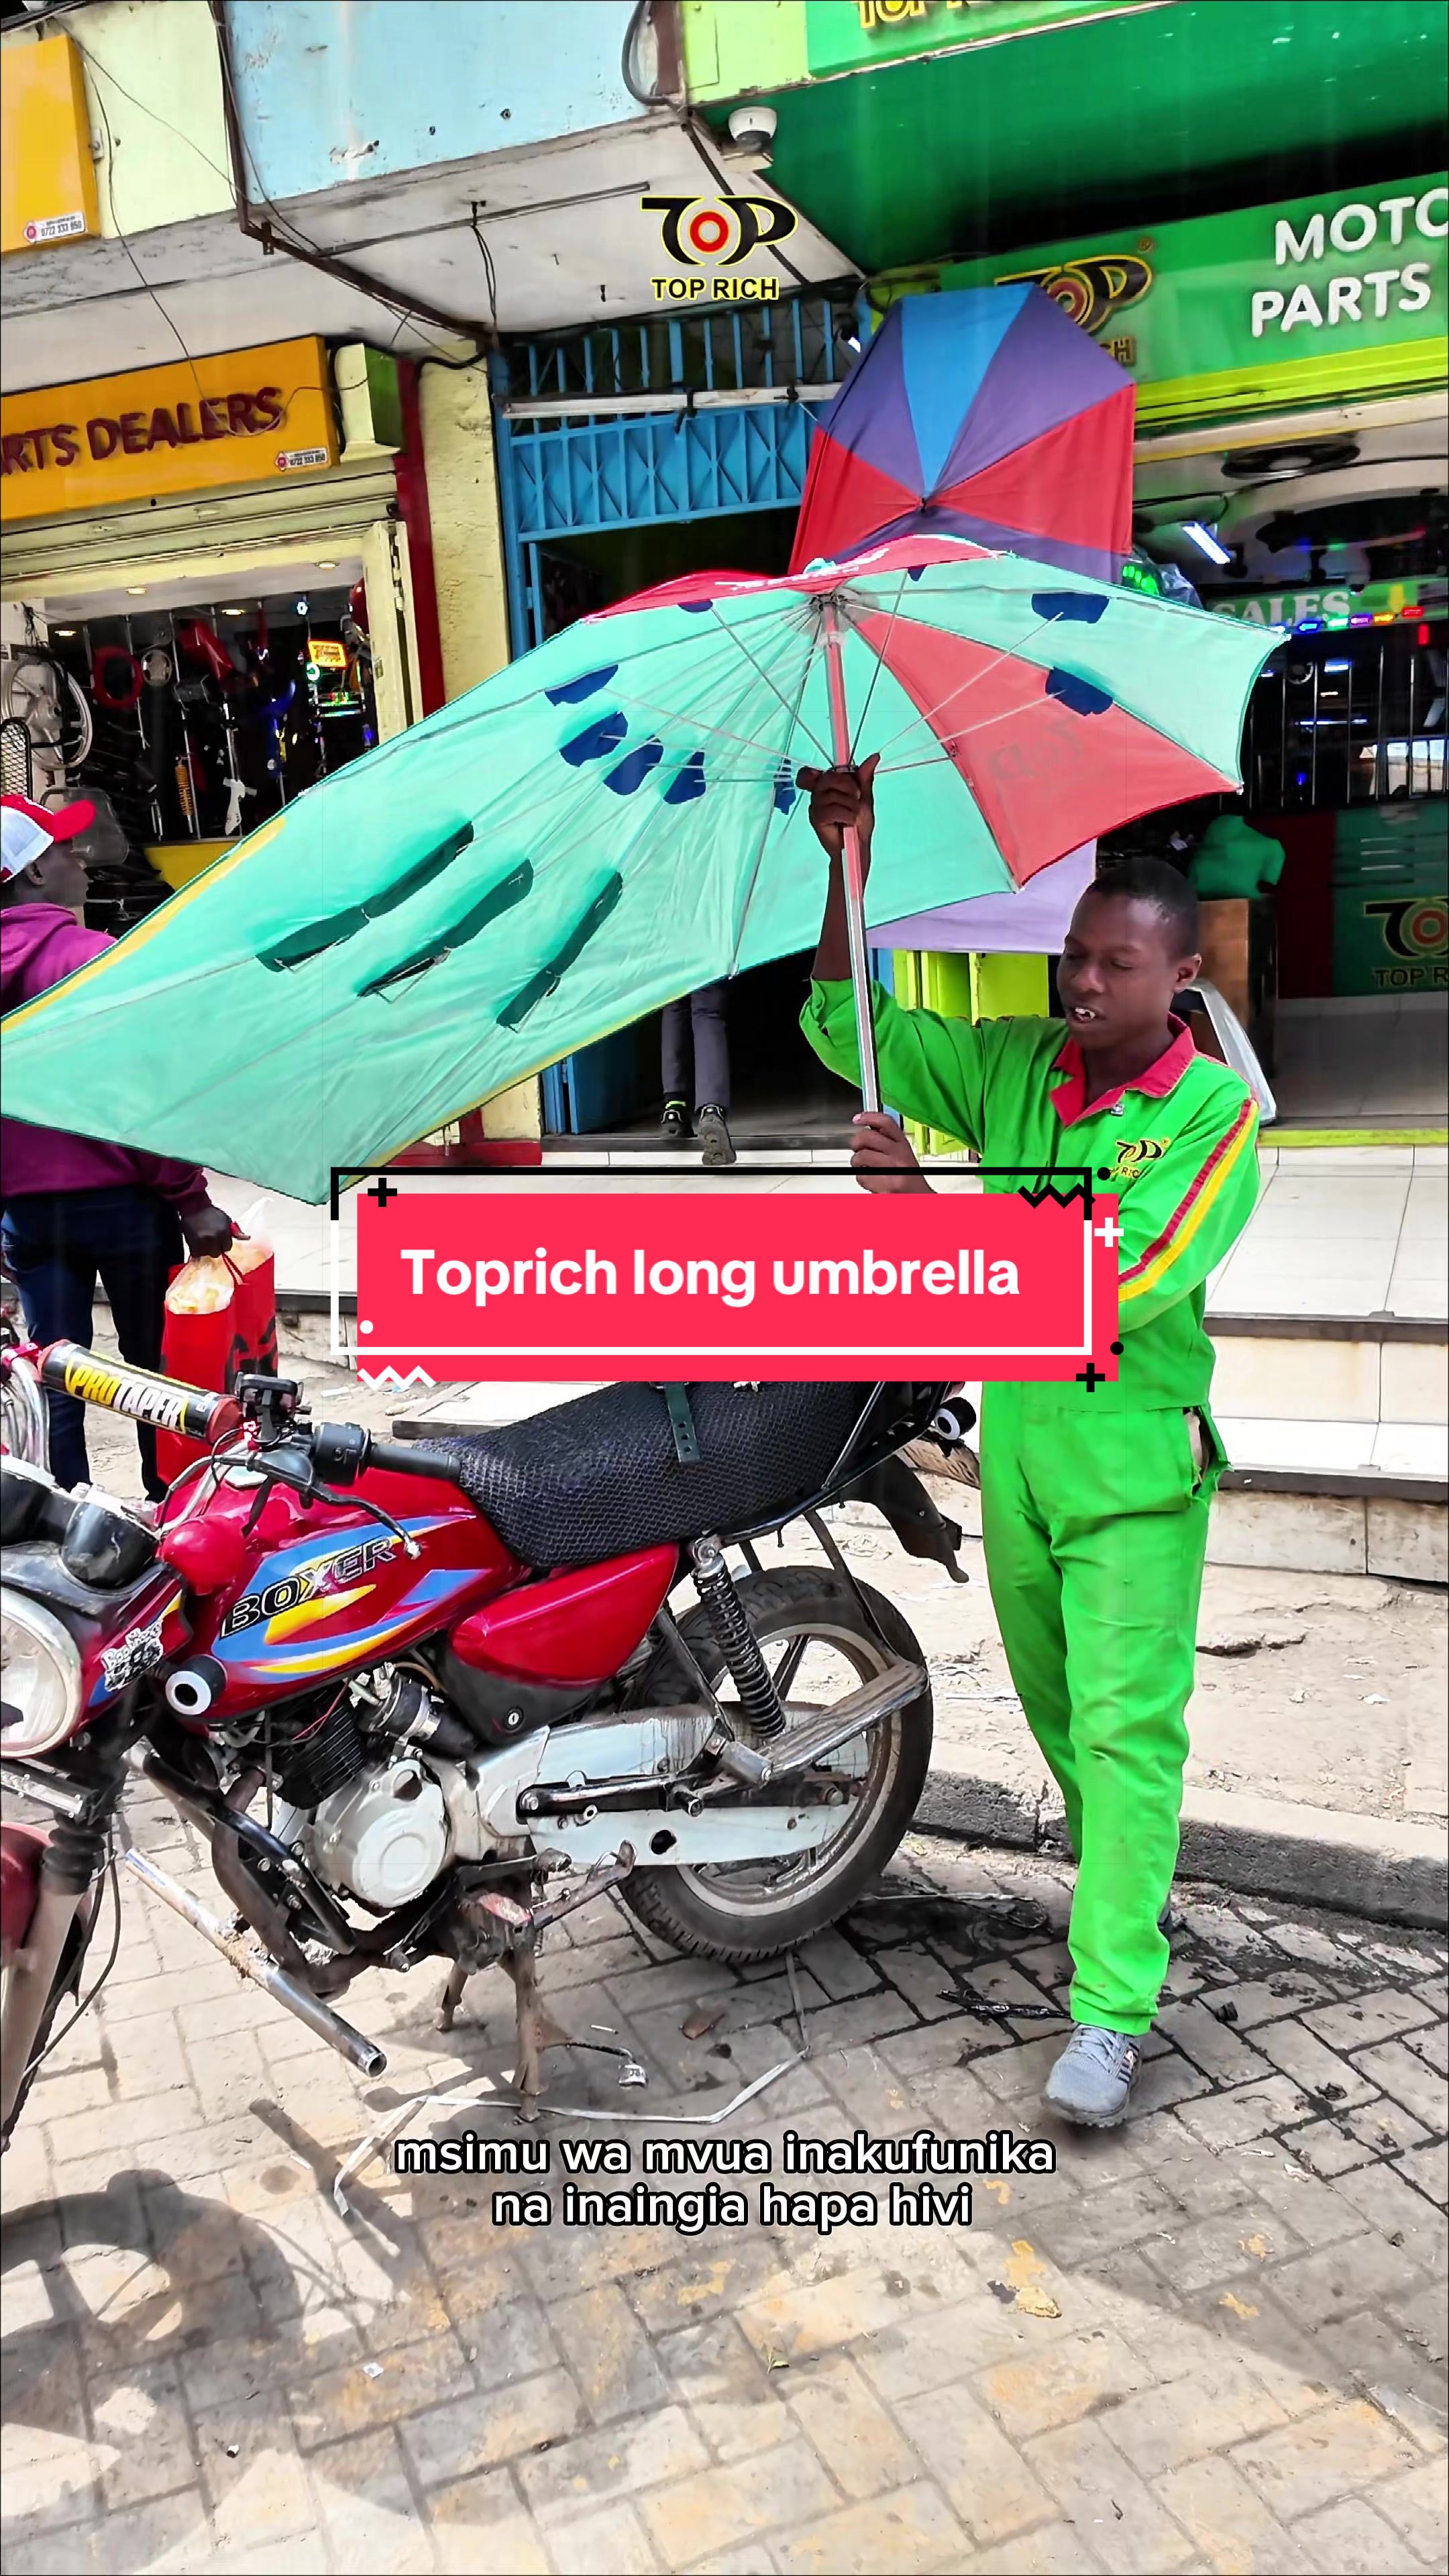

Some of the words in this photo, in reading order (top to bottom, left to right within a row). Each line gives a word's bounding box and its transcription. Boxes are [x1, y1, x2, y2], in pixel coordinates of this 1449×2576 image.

[1252, 262, 1432, 337] PARTS
[1, 423, 80, 475] RTS
[86, 386, 284, 461] DEALERS
[1373, 967, 1426, 987] TOP
[219, 1535, 398, 1640] BOXER
